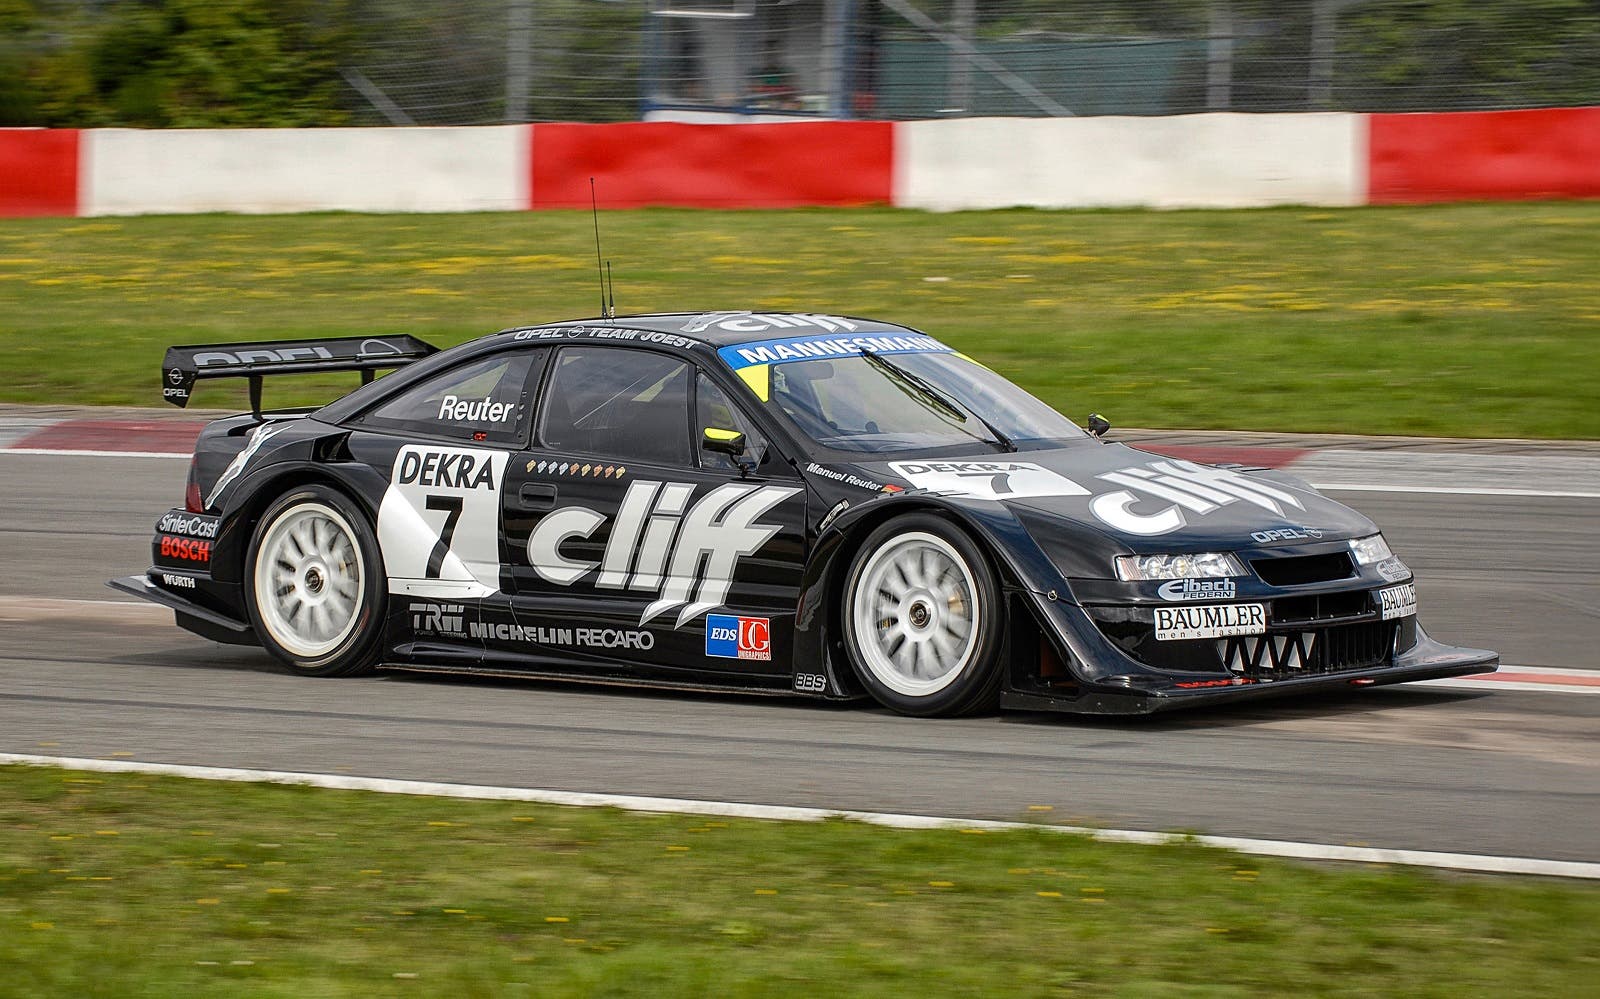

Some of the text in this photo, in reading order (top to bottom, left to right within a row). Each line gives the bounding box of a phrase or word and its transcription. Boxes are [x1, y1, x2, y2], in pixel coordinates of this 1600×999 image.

[514, 327, 701, 350] OPEL TEAM JOEST
[163, 388, 188, 398] OPEL
[438, 395, 515, 422] Reuter
[399, 451, 495, 491] DEKRA
[806, 462, 882, 491] Manuel Reuter
[898, 463, 1042, 475] DEKRA
[956, 473, 1013, 494] 7
[1089, 460, 1308, 537] cliff
[159, 513, 219, 538] SinterCast
[425, 494, 463, 579] 7
[1250, 526, 1307, 543] OPEL
[161, 536, 210, 561] BOSCH
[527, 480, 804, 630] cliff
[1183, 591, 1231, 599] FEDERN
[409, 603, 465, 632] TRW
[1156, 605, 1264, 631] BÄUMLER
[469, 622, 655, 650] MICHELIN RECARO
[711, 627, 737, 641] EDS
[738, 620, 769, 650] UG
[795, 672, 827, 691] BBS
